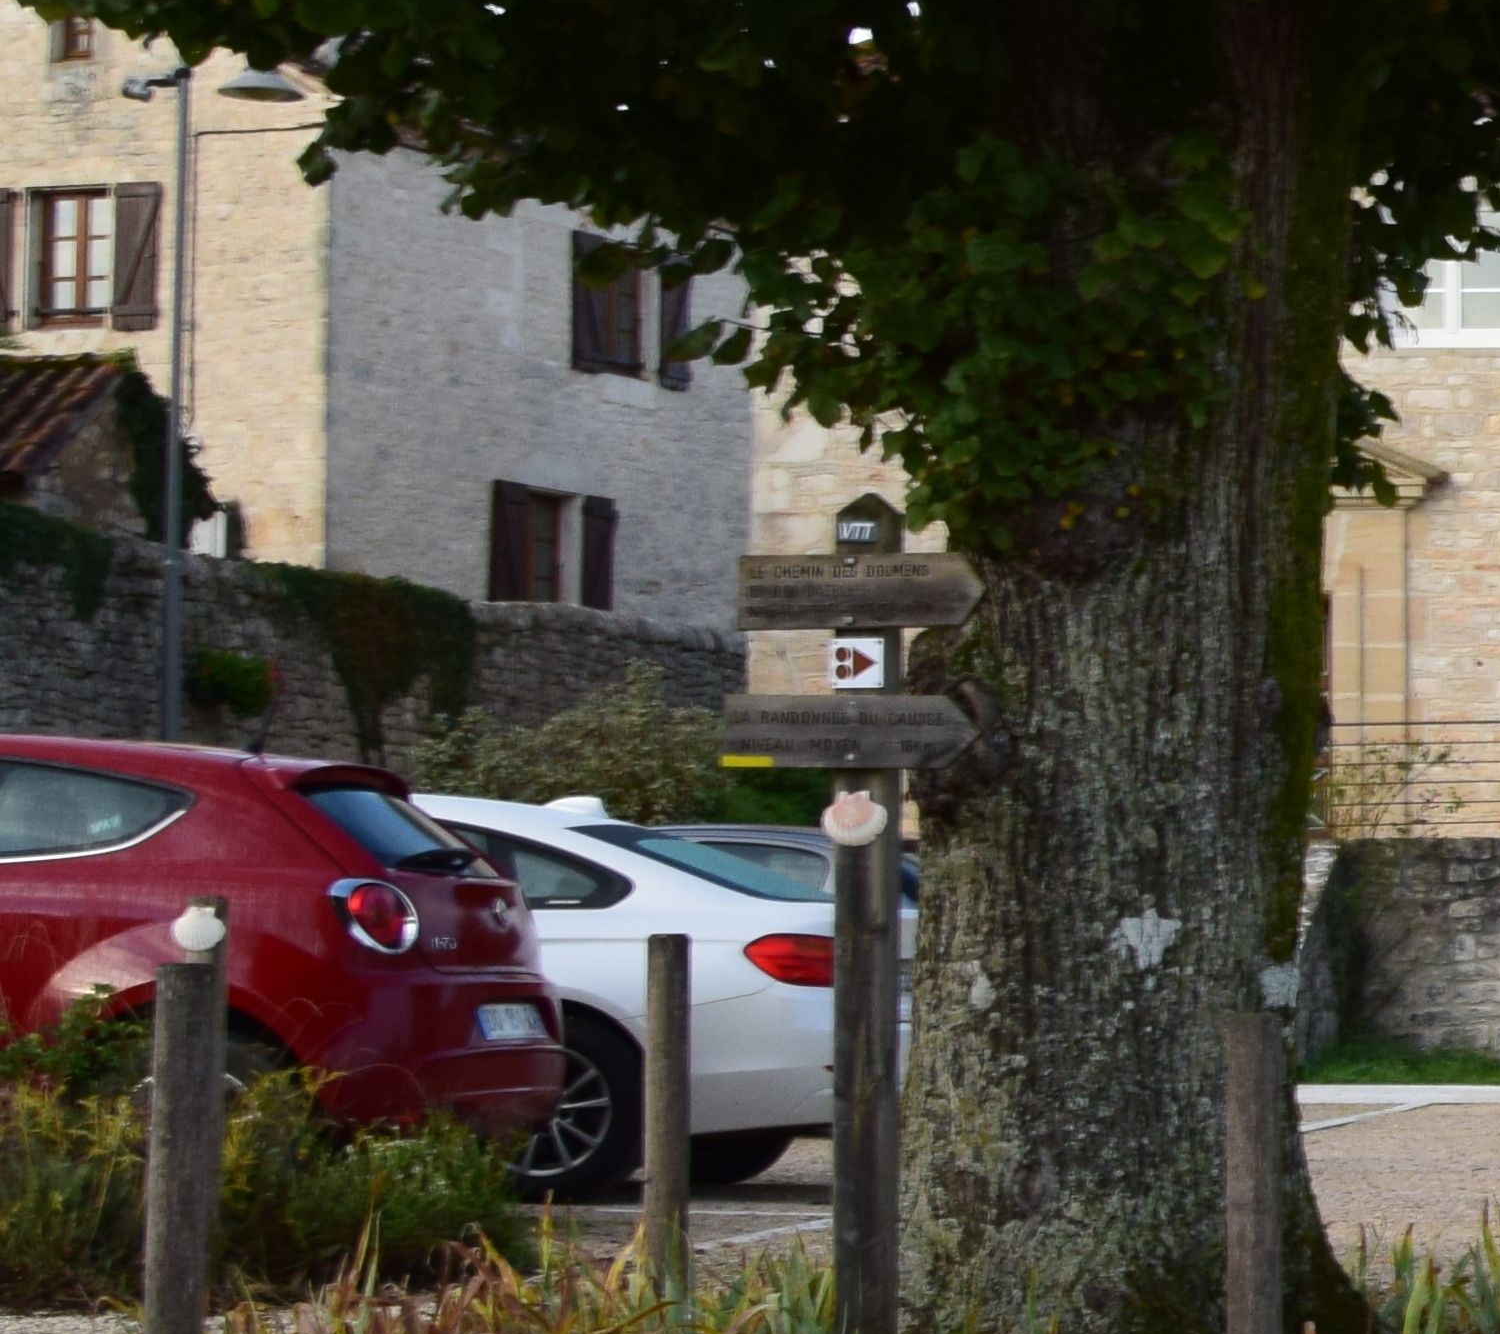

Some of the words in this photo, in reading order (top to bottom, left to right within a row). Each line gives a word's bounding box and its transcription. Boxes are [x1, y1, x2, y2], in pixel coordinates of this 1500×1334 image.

[838, 523, 875, 540] VTT
[750, 567, 765, 579] LE
[774, 566, 824, 579] CHEMIN
[832, 565, 858, 579] DES
[866, 565, 930, 578] DOLMENS
[858, 711, 878, 725] DU
[887, 712, 945, 726] CAUSSE
[740, 738, 795, 752] NIVEAU
[809, 738, 862, 752] MOYEN
